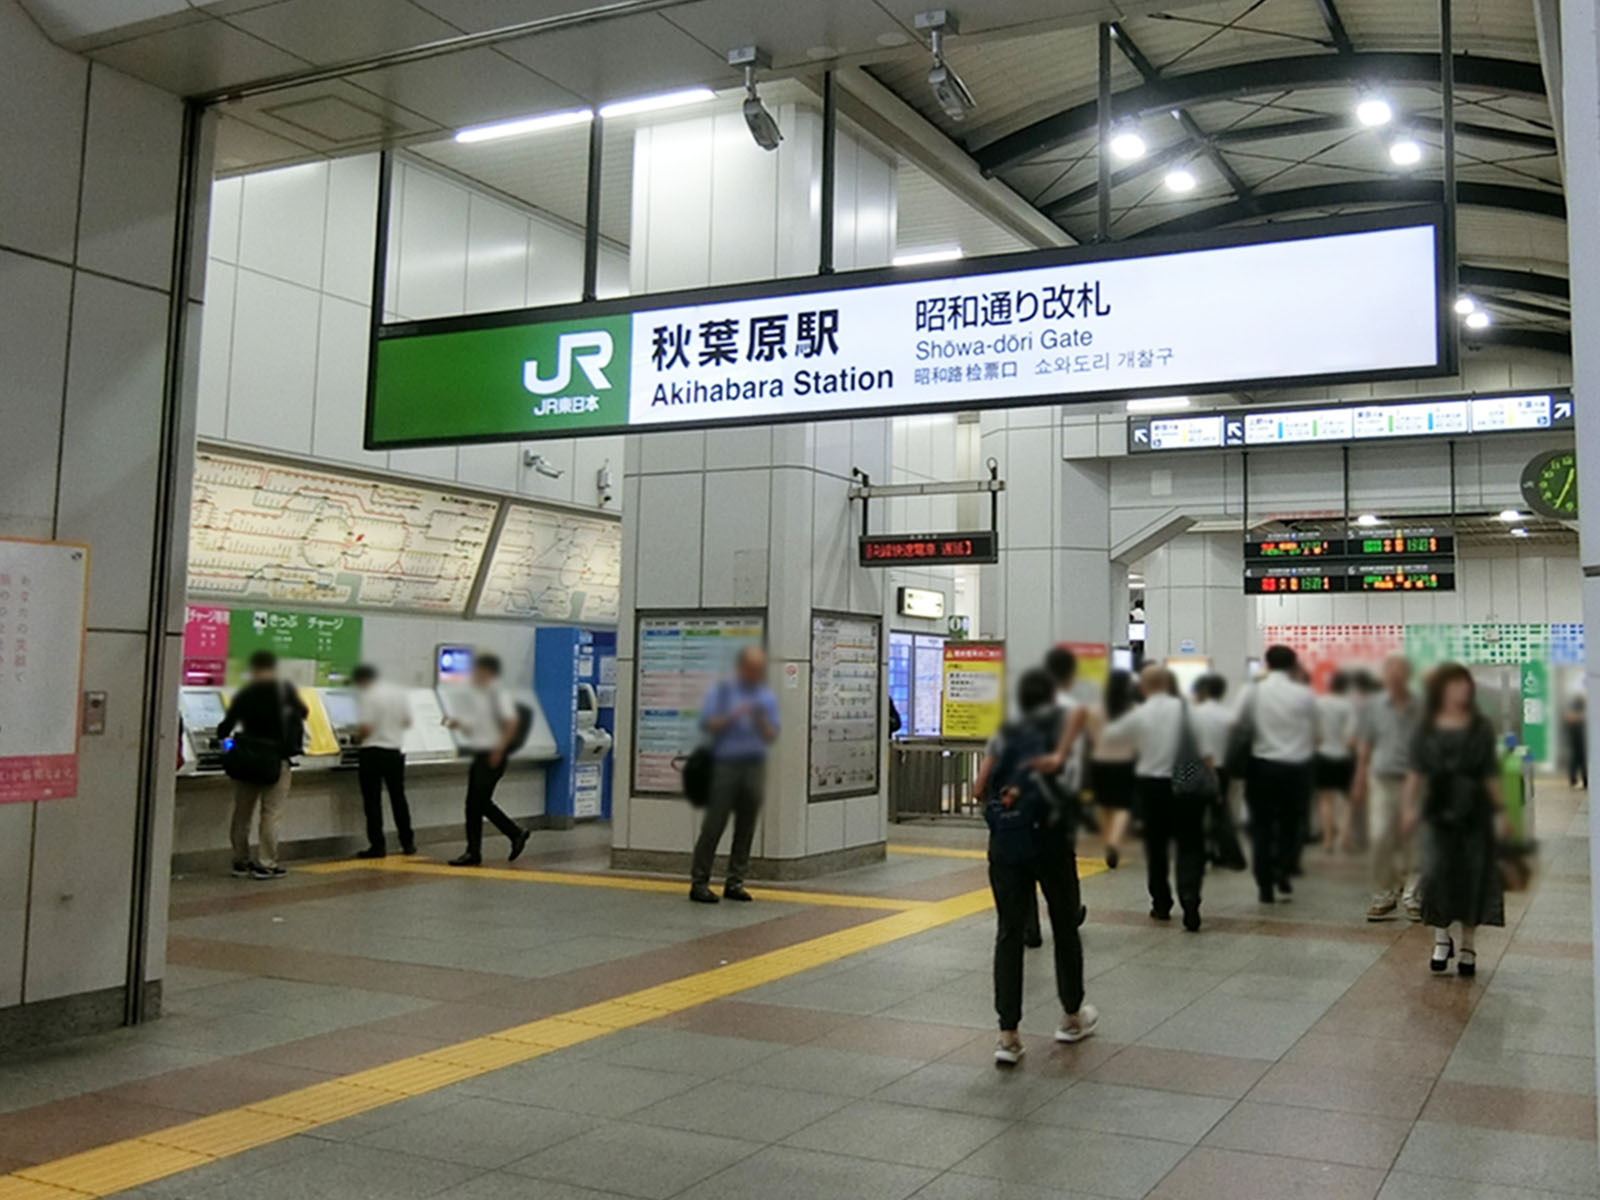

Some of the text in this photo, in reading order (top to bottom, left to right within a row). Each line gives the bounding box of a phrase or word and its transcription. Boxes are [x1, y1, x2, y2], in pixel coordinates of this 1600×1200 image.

[914, 280, 1111, 332] 昭和通り改札
[651, 309, 839, 372] 秋葉原駅
[915, 328, 1093, 361] Shōwa-dōri Gate
[523, 330, 614, 395] JR
[1034, 347, 1174, 376] 쇼와도리 개찰구
[533, 394, 600, 416] JR東日本
[651, 366, 894, 407] Akihabara Station
